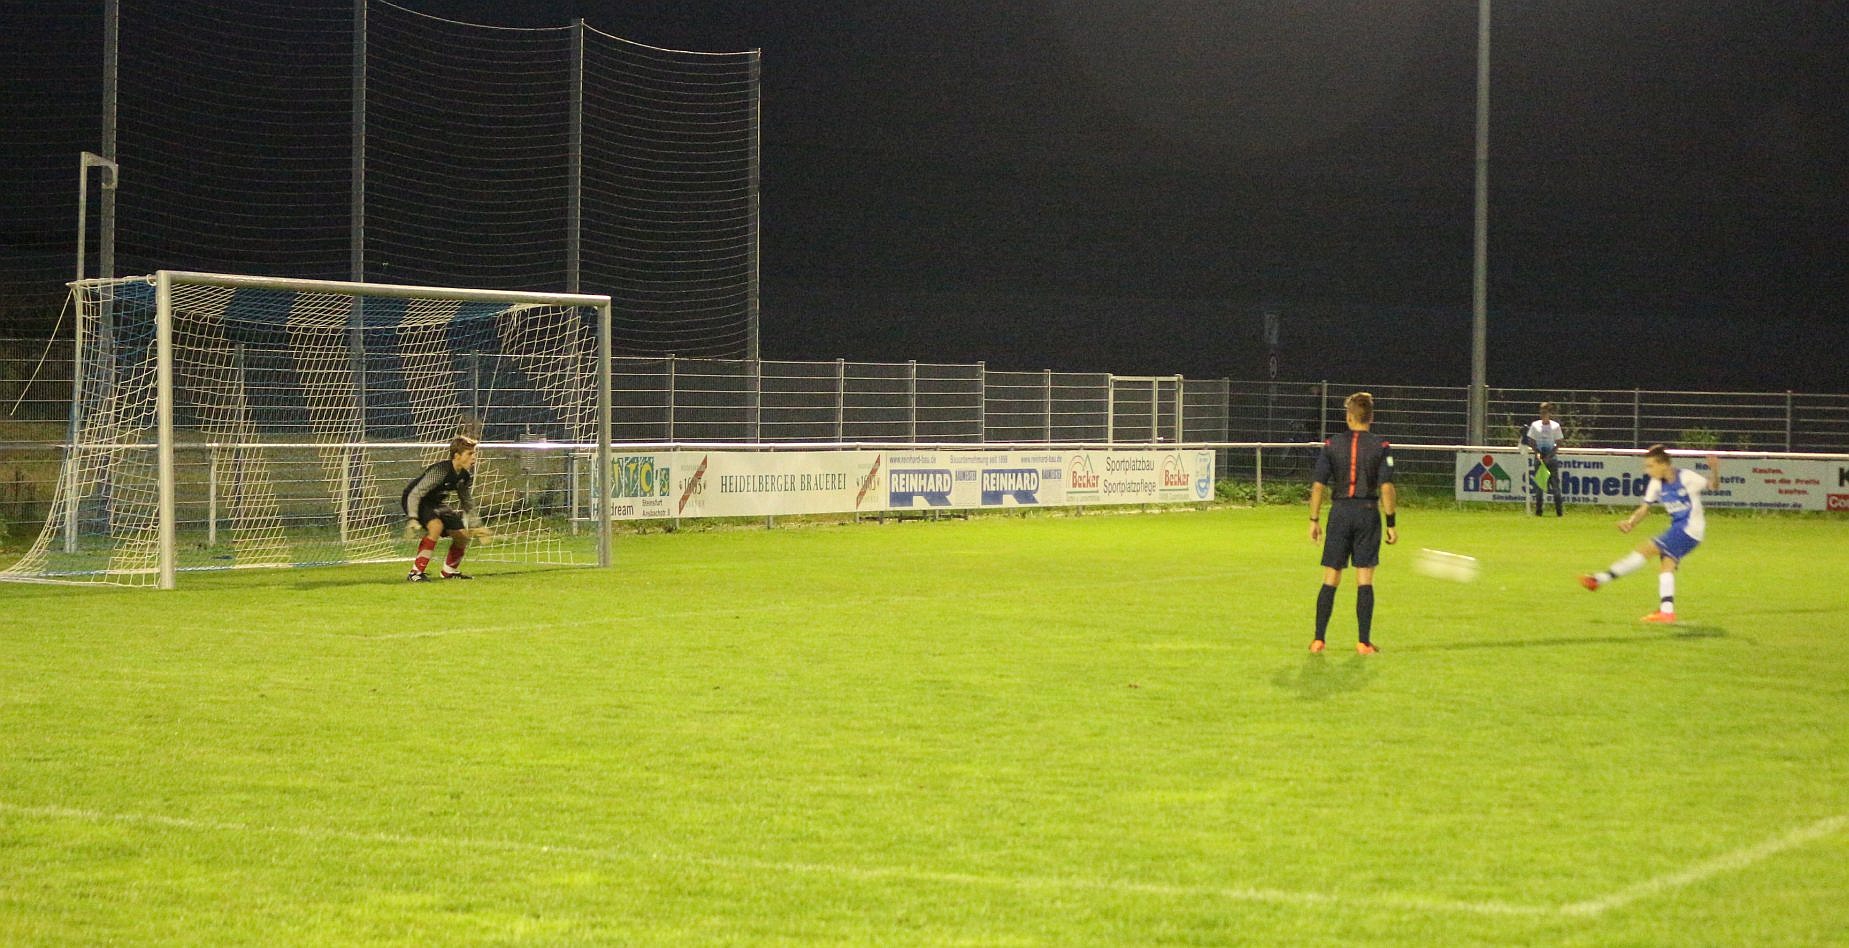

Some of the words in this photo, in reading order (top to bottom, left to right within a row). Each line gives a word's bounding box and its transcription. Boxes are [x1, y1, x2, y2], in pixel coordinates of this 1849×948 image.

[1106, 456, 1155, 475] Sportplatzbau
[720, 474, 796, 493] HEIDELBERGER
[800, 472, 847, 491] BRAUEREI
[890, 473, 952, 493] REINHARD
[982, 472, 1039, 491] REINHARD
[1071, 470, 1100, 489] Becker
[1103, 478, 1157, 497] Sportplatzpflege
[1164, 469, 1190, 487] Becker
